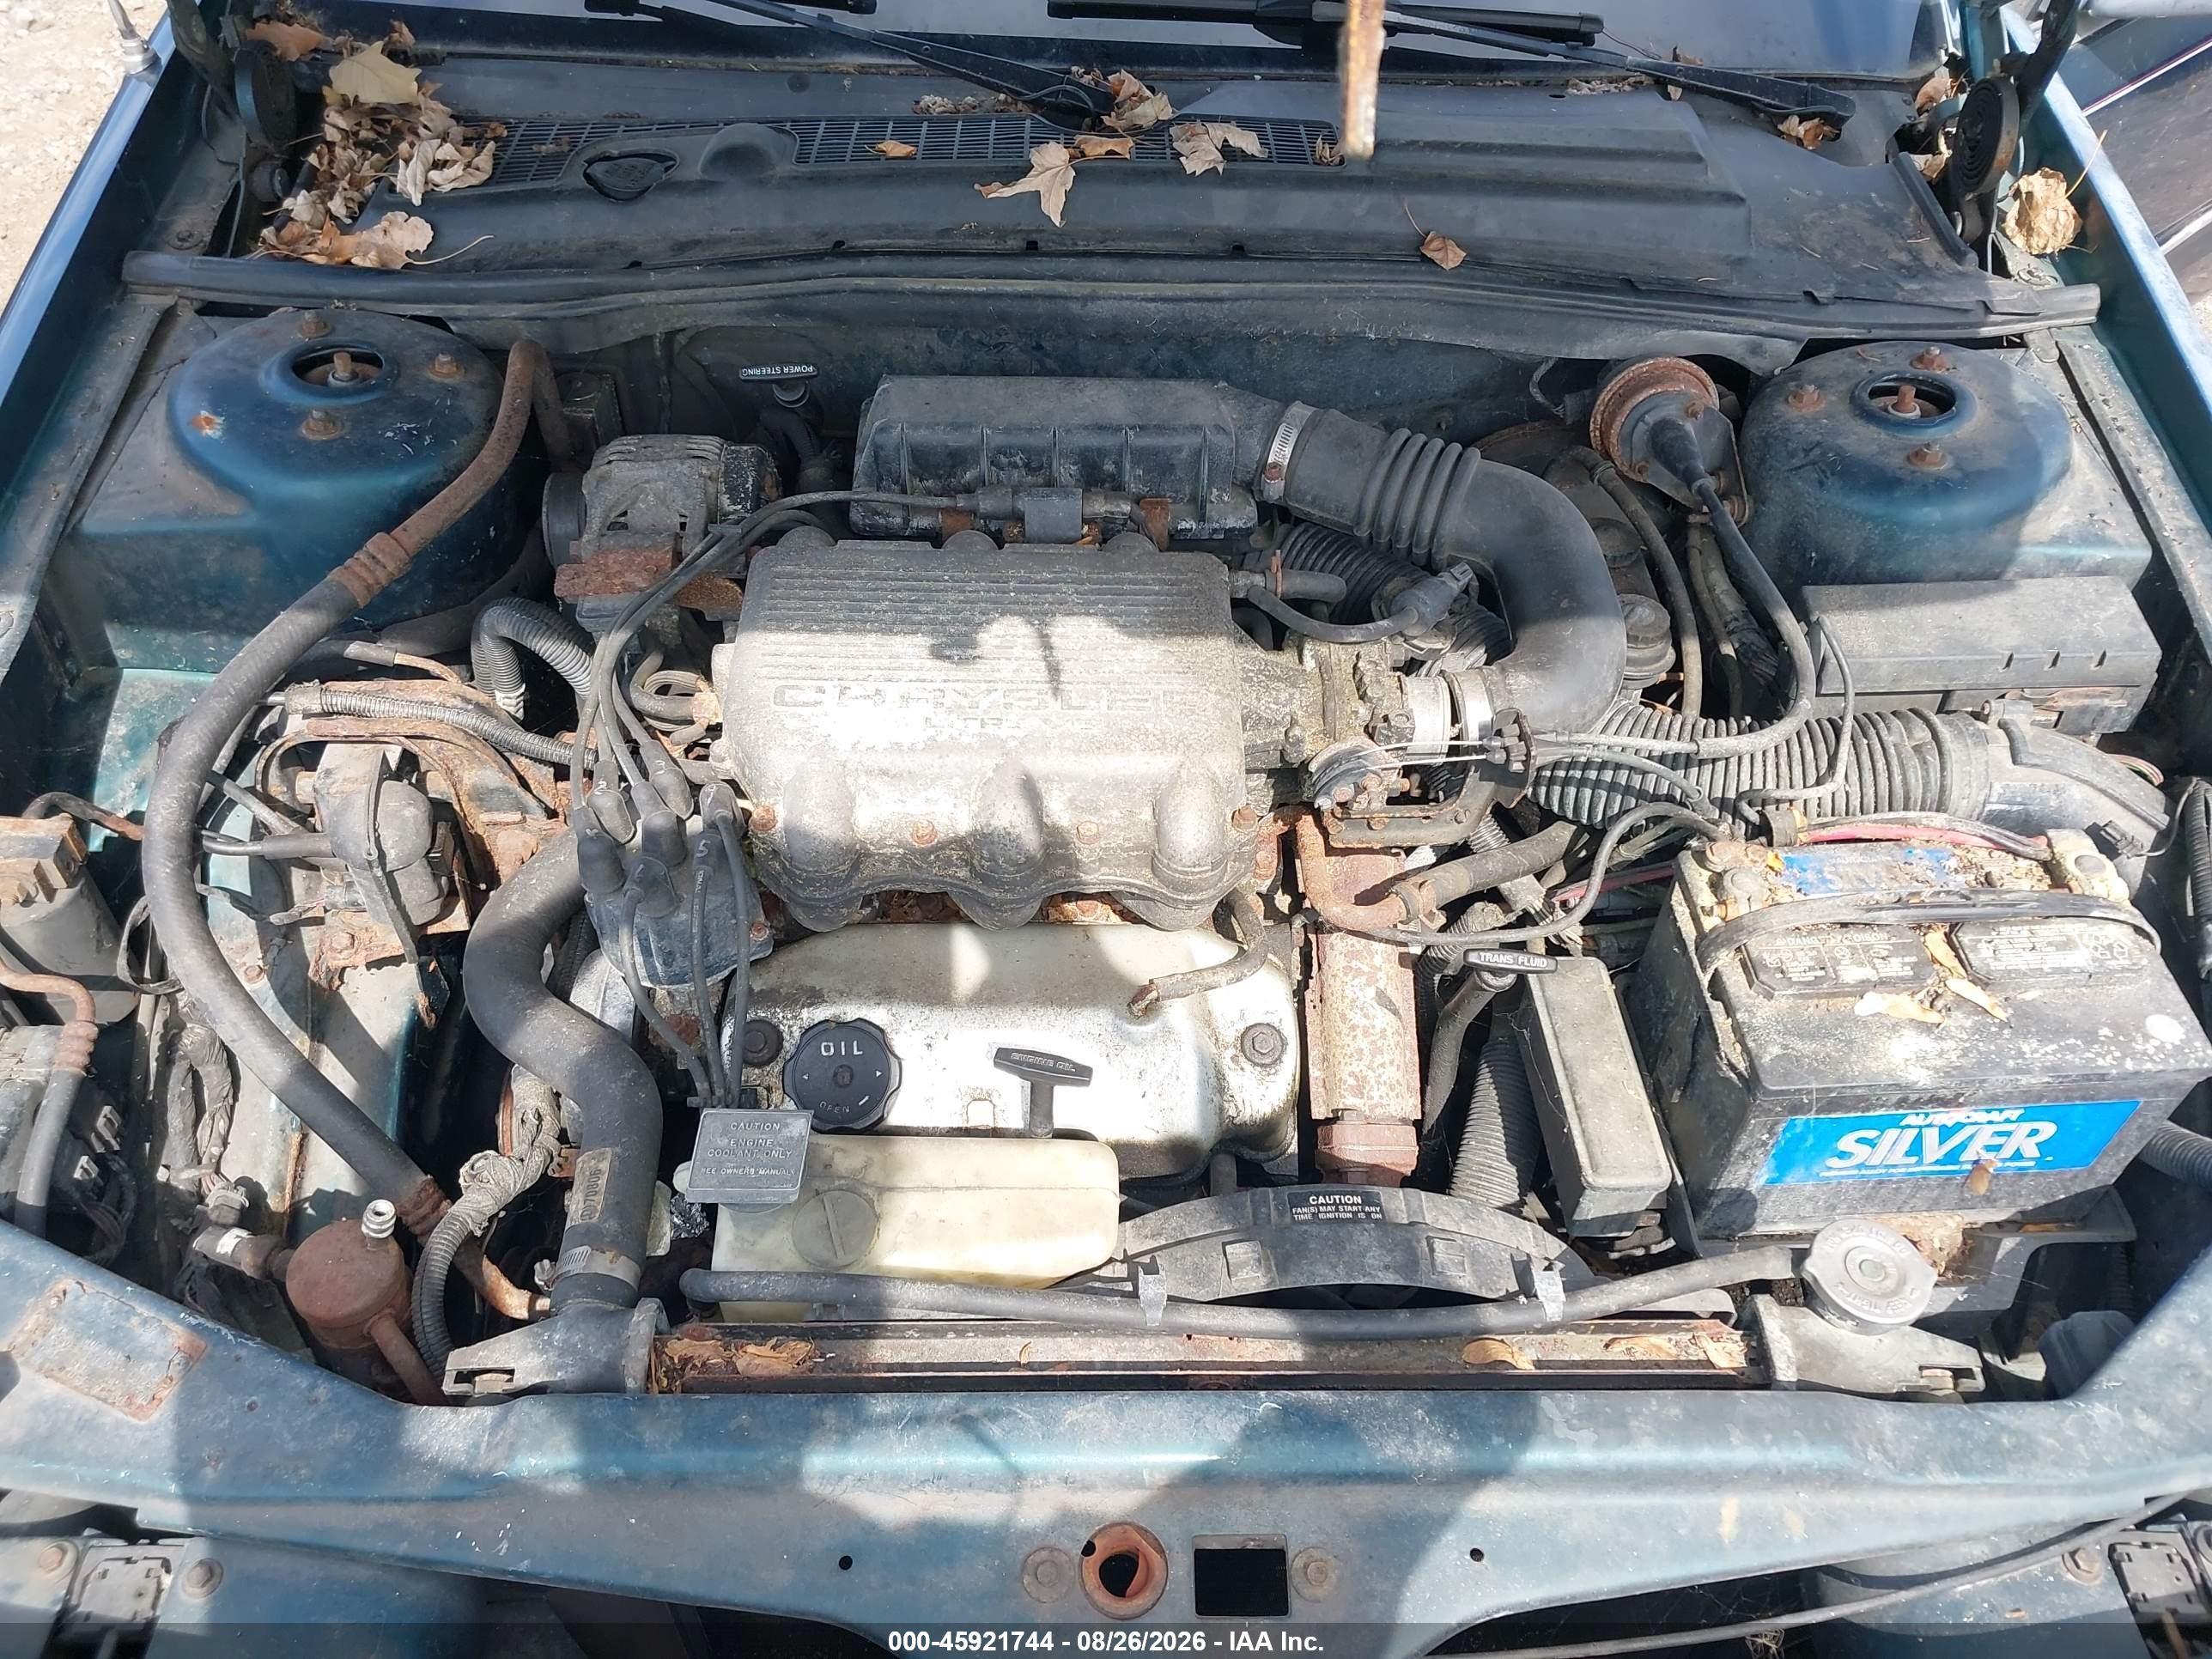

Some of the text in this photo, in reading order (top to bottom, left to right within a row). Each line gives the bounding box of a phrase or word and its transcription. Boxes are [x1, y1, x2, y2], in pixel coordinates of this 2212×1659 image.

[742, 365, 813, 376] POWER STEERING
[696, 839, 710, 858] 5
[1479, 951, 1547, 968] TRANS FLUID
[820, 1039, 864, 1056] OIL
[1011, 1052, 1076, 1073] ENGINE OIL
[730, 1121, 781, 1131] CAUTION
[729, 1139, 775, 1147] ENGINE
[1824, 1121, 2057, 1170] SILVER
[707, 1149, 793, 1158] COOLANT ONLY
[1309, 1194, 1362, 1204] CAUTION
[1292, 1206, 1318, 1214] FAN(S)
